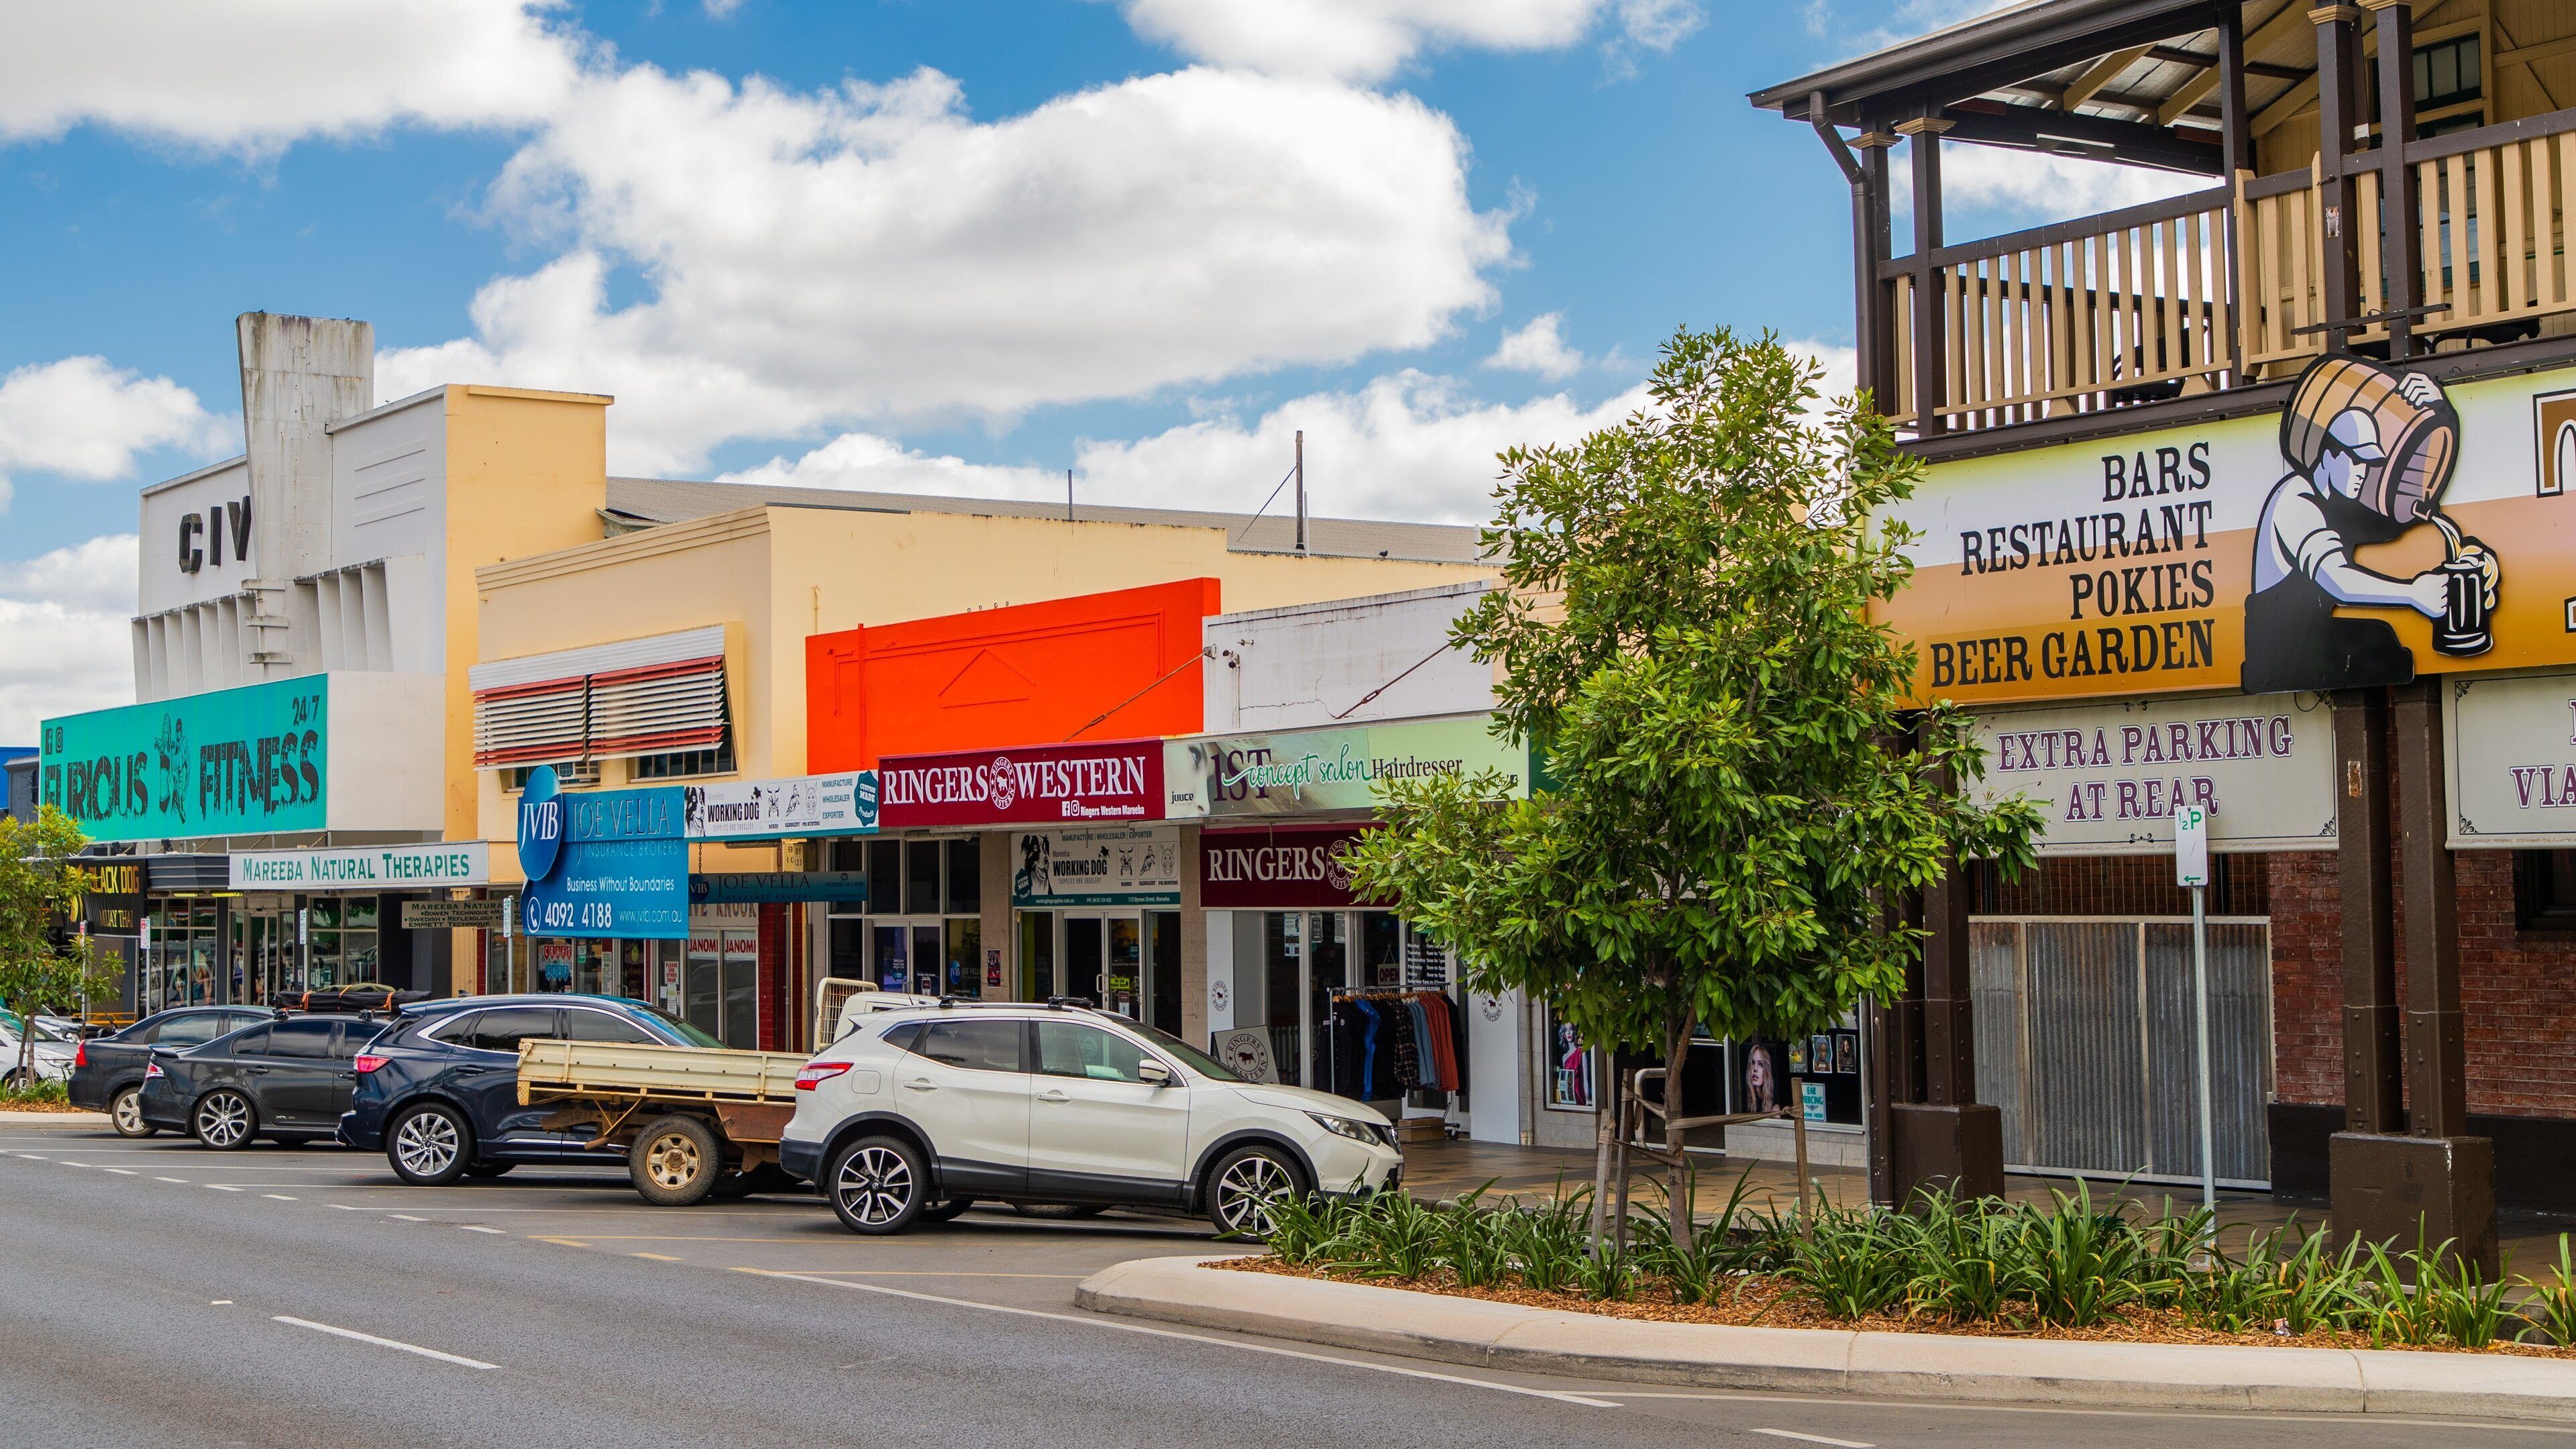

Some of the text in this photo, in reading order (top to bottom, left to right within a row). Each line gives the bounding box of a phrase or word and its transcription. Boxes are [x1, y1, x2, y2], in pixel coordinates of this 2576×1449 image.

[2102, 442, 2211, 502] BARS
[179, 496, 252, 574] CIV
[1961, 500, 2212, 576] RESTAURANT
[2070, 559, 2214, 619] POKIES
[1930, 619, 2214, 688] BEER GARDEN
[292, 695, 319, 725] 24/7
[1996, 714, 2294, 773] EXTRA PARKING
[200, 730, 319, 820] FITNESS
[991, 757, 1013, 775] RINGERS
[1222, 752, 1320, 800] concept
[1320, 743, 1373, 784] salon
[1372, 755, 1462, 780] Hairdresser
[822, 779, 853, 788] MANUFACTURE
[859, 783, 876, 794] CUSTOM
[883, 757, 1145, 805] RINGERS WESTERN
[822, 794, 850, 803] WHOLESALER
[859, 790, 875, 802] MADE
[991, 787, 1014, 806] WESTERN
[1171, 791, 1193, 804] juuce
[2065, 775, 2220, 822] AT REAR
[708, 802, 759, 822] WORKING DOG
[822, 811, 844, 820] EXPORTER
[1081, 804, 1144, 818] Ringers Western Mareeba
[519, 802, 558, 852] JVIB
[574, 798, 671, 865] JOE VELLA
[1062, 833, 1093, 841] MANUFACTURE
[1097, 832, 1126, 840] WHOLESALER
[586, 840, 678, 857] INSURANCE BROKERS
[1330, 842, 1347, 855] INGE
[244, 853, 470, 881] MAREEBA NATURAL THERAPIES
[1053, 859, 1107, 876] WORKING DOG
[1208, 846, 1325, 881] RINGERS
[121, 865, 140, 894] DOG
[567, 875, 674, 892] Business Without Boundaries
[690, 883, 708, 894] VIB
[718, 873, 810, 898] JOE VELLA
[100, 910, 133, 928] MUAY THAI
[545, 902, 612, 928] 4092 4188
[619, 907, 682, 926] www.jvib.com.au
[545, 946, 571, 956] CRAFT
[1379, 968, 1400, 982] OPEN
[1228, 1035, 1261, 1052] RINGERS
[1803, 1095, 1823, 1105] IERCING
[1807, 1087, 1816, 1095] EAR
